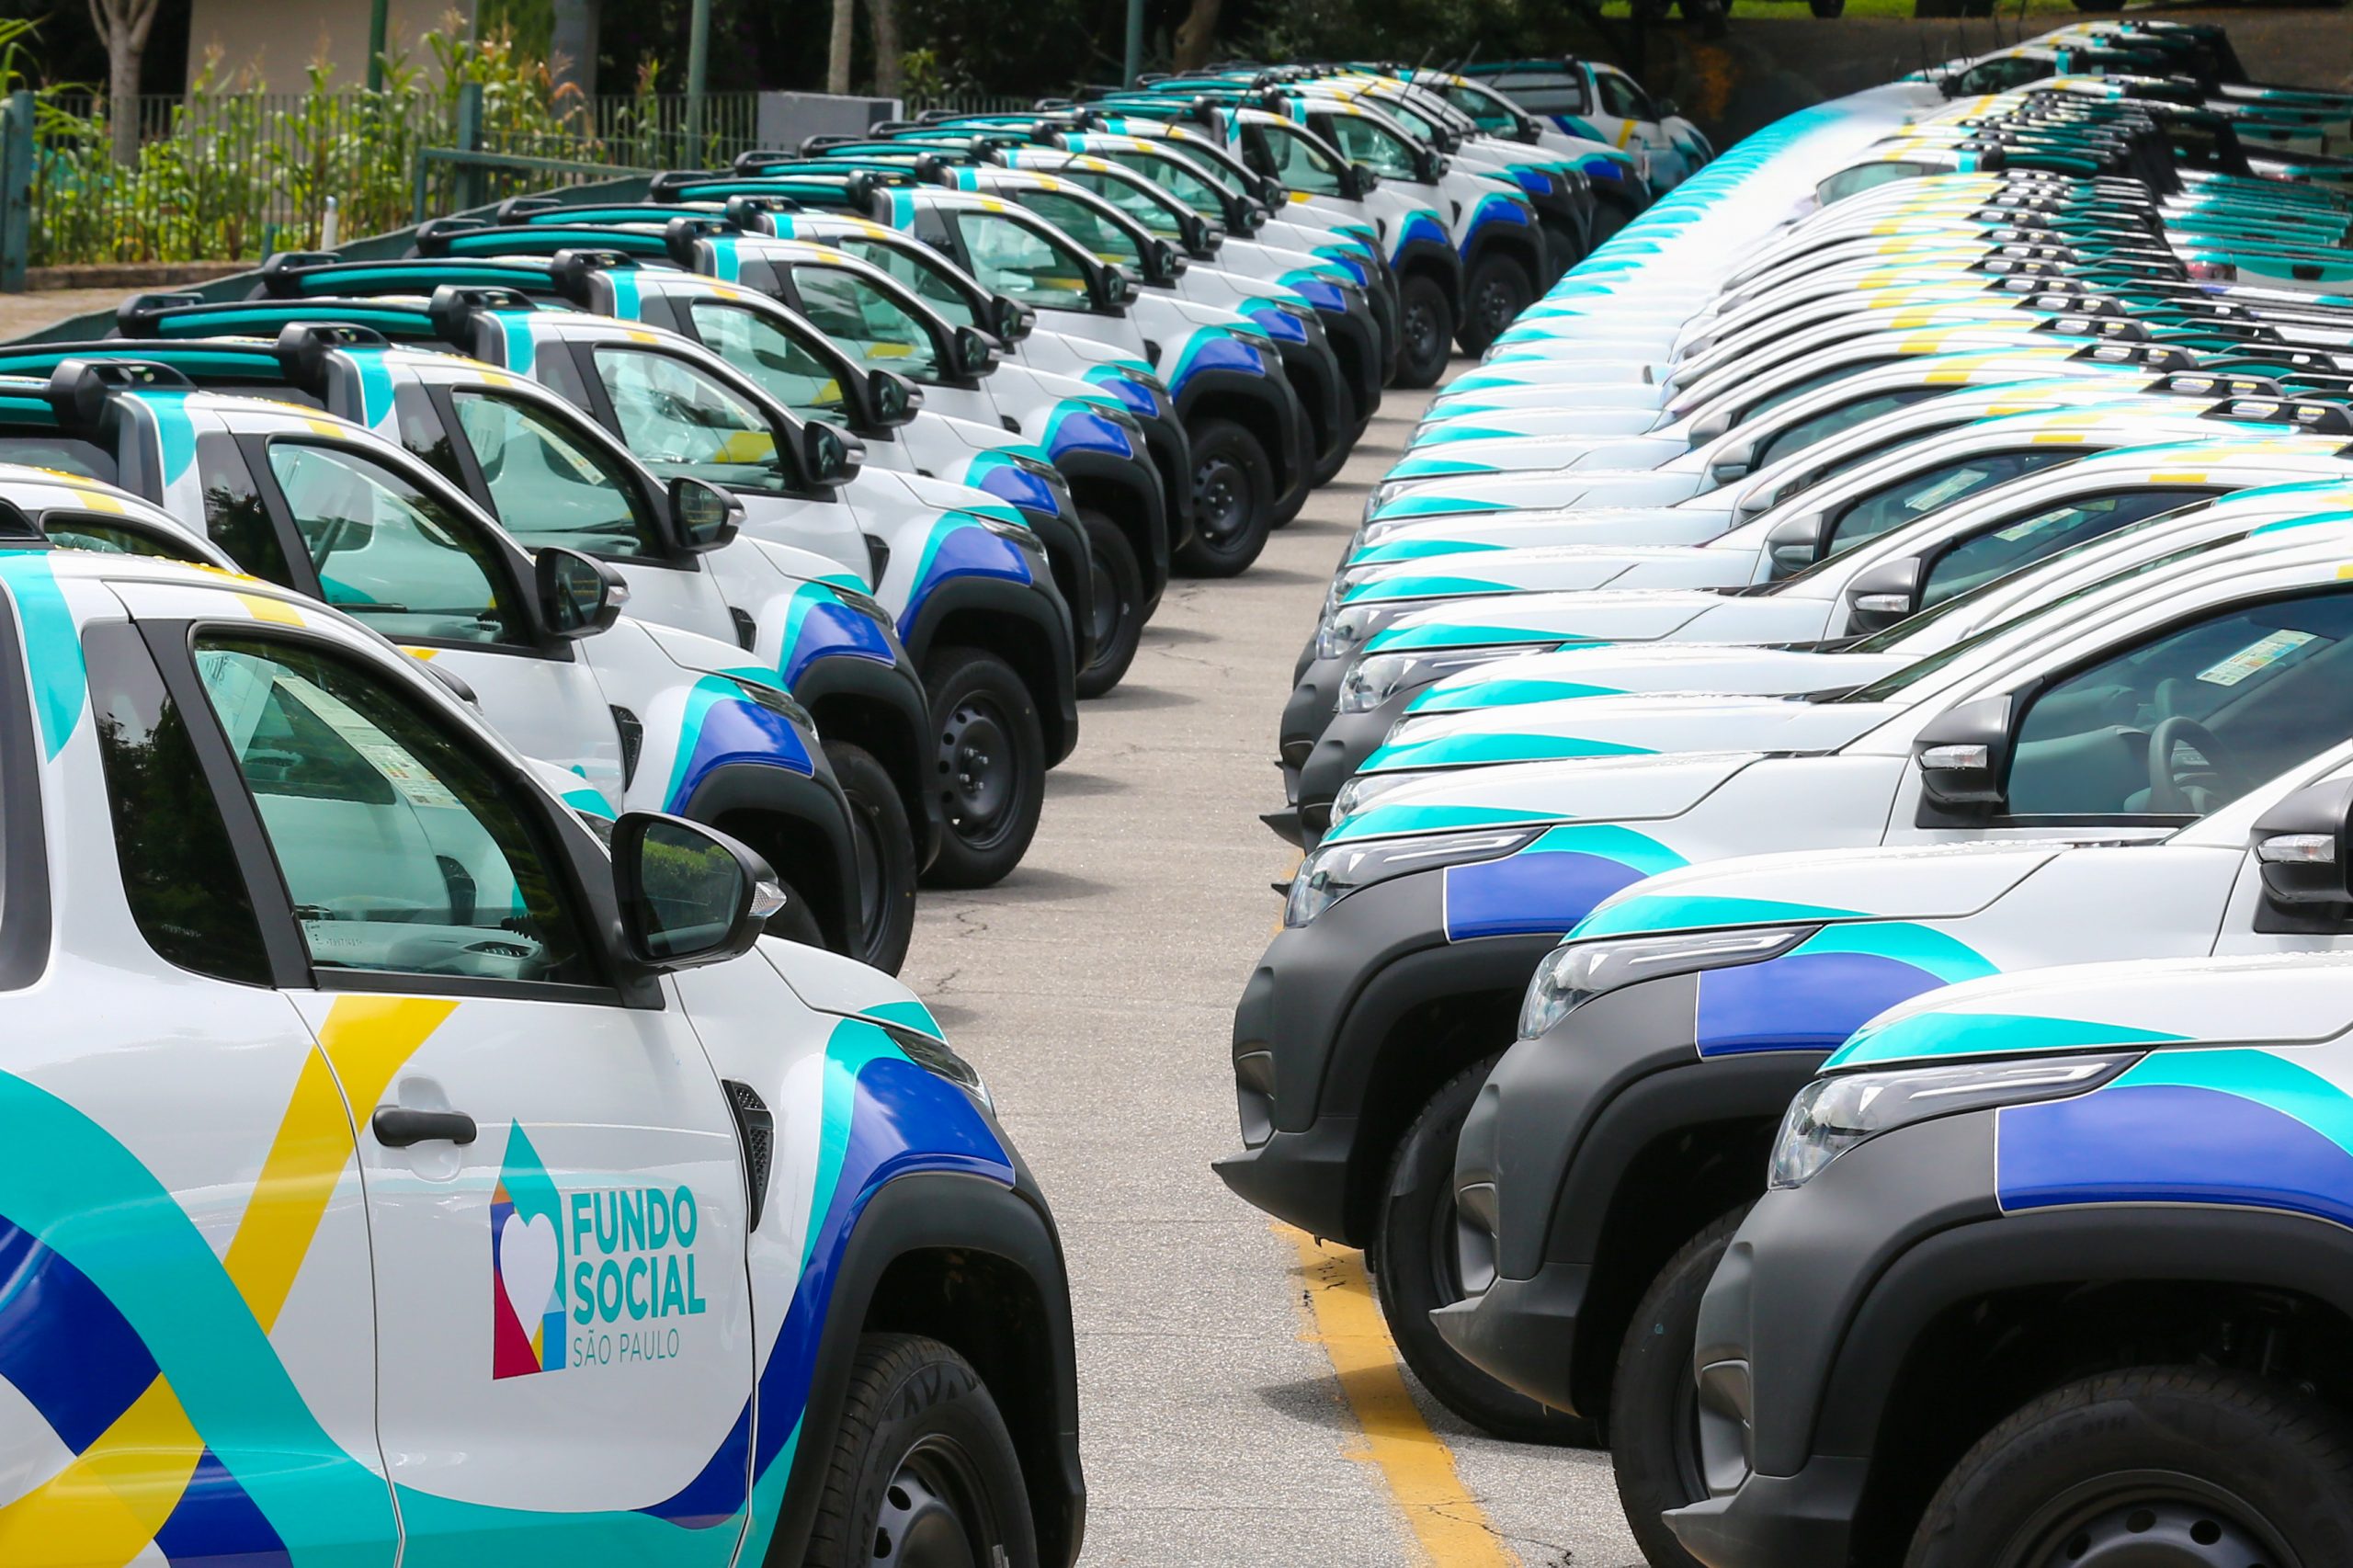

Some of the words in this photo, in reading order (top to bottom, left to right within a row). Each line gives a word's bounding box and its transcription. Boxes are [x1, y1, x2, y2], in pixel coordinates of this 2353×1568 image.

[571, 1185, 697, 1256] FUNDO
[574, 1254, 706, 1325] SOCIAL
[574, 1329, 611, 1368] SÃO
[620, 1328, 679, 1363] PAULO
